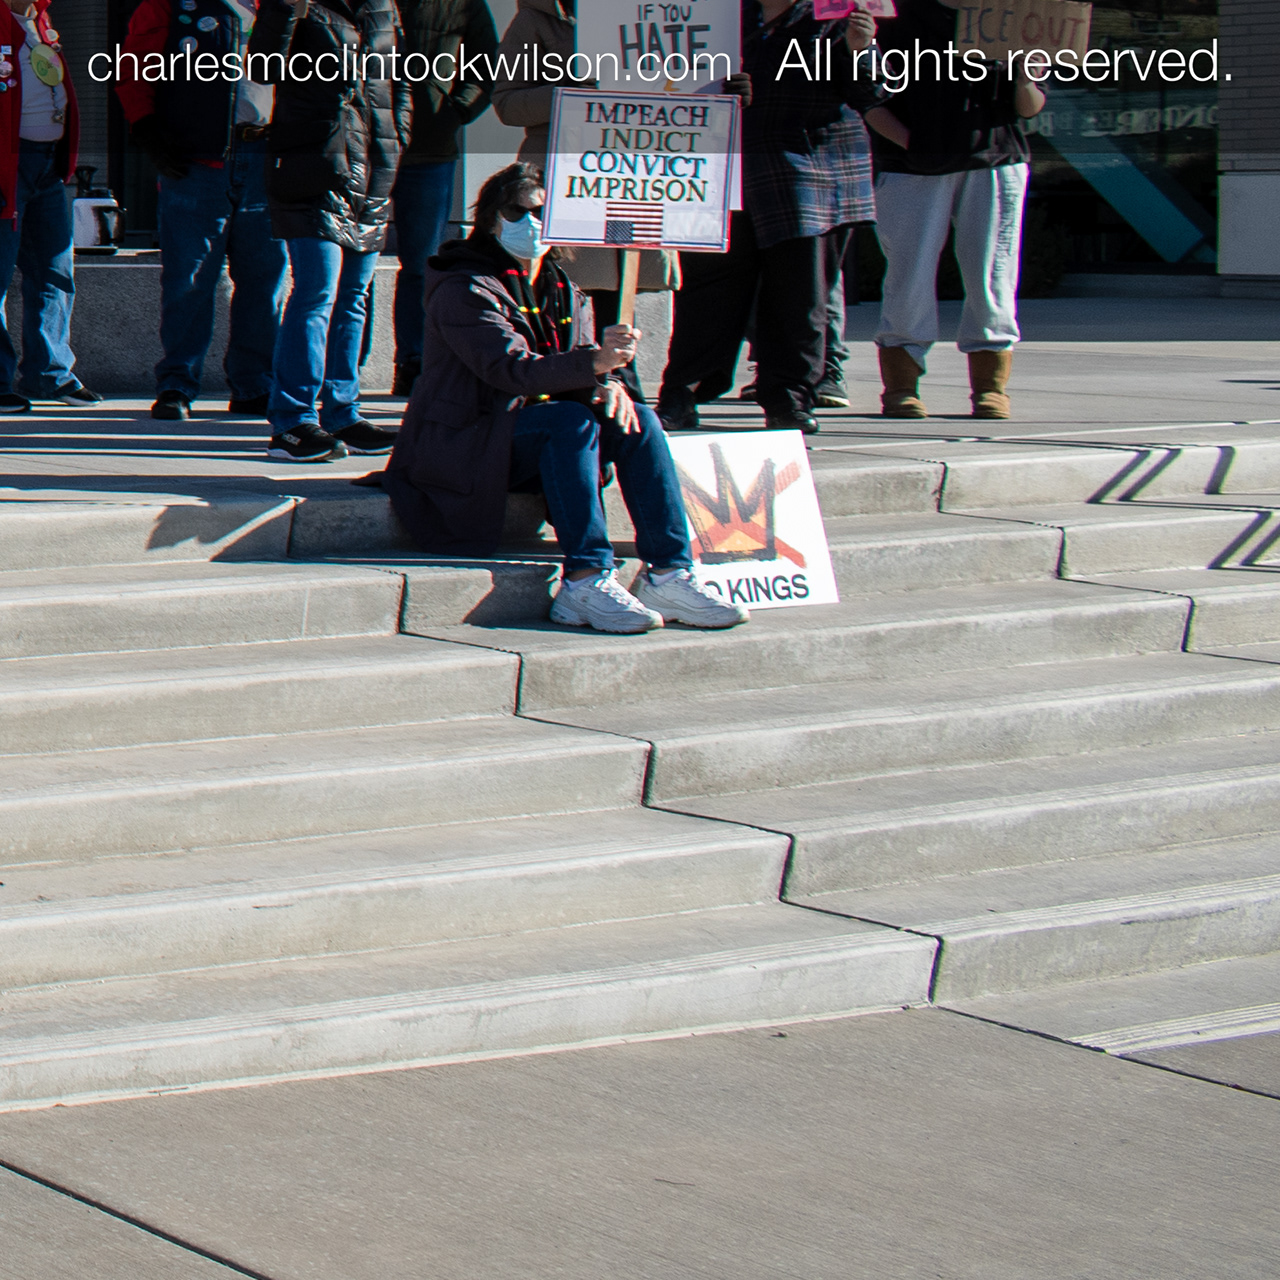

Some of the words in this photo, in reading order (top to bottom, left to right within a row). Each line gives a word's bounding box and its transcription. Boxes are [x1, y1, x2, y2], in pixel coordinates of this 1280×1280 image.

[637, 5, 654, 21] IF
[658, 3, 693, 22] YOU
[961, 6, 1015, 44] ICE
[1021, 11, 1086, 50] OUT
[618, 23, 711, 71] HATE
[584, 101, 710, 128] IMPEACH
[600, 128, 702, 154] INDICT
[578, 150, 707, 179] CONVICT
[564, 175, 709, 203] IMPRISON
[726, 573, 811, 605] KINGS
